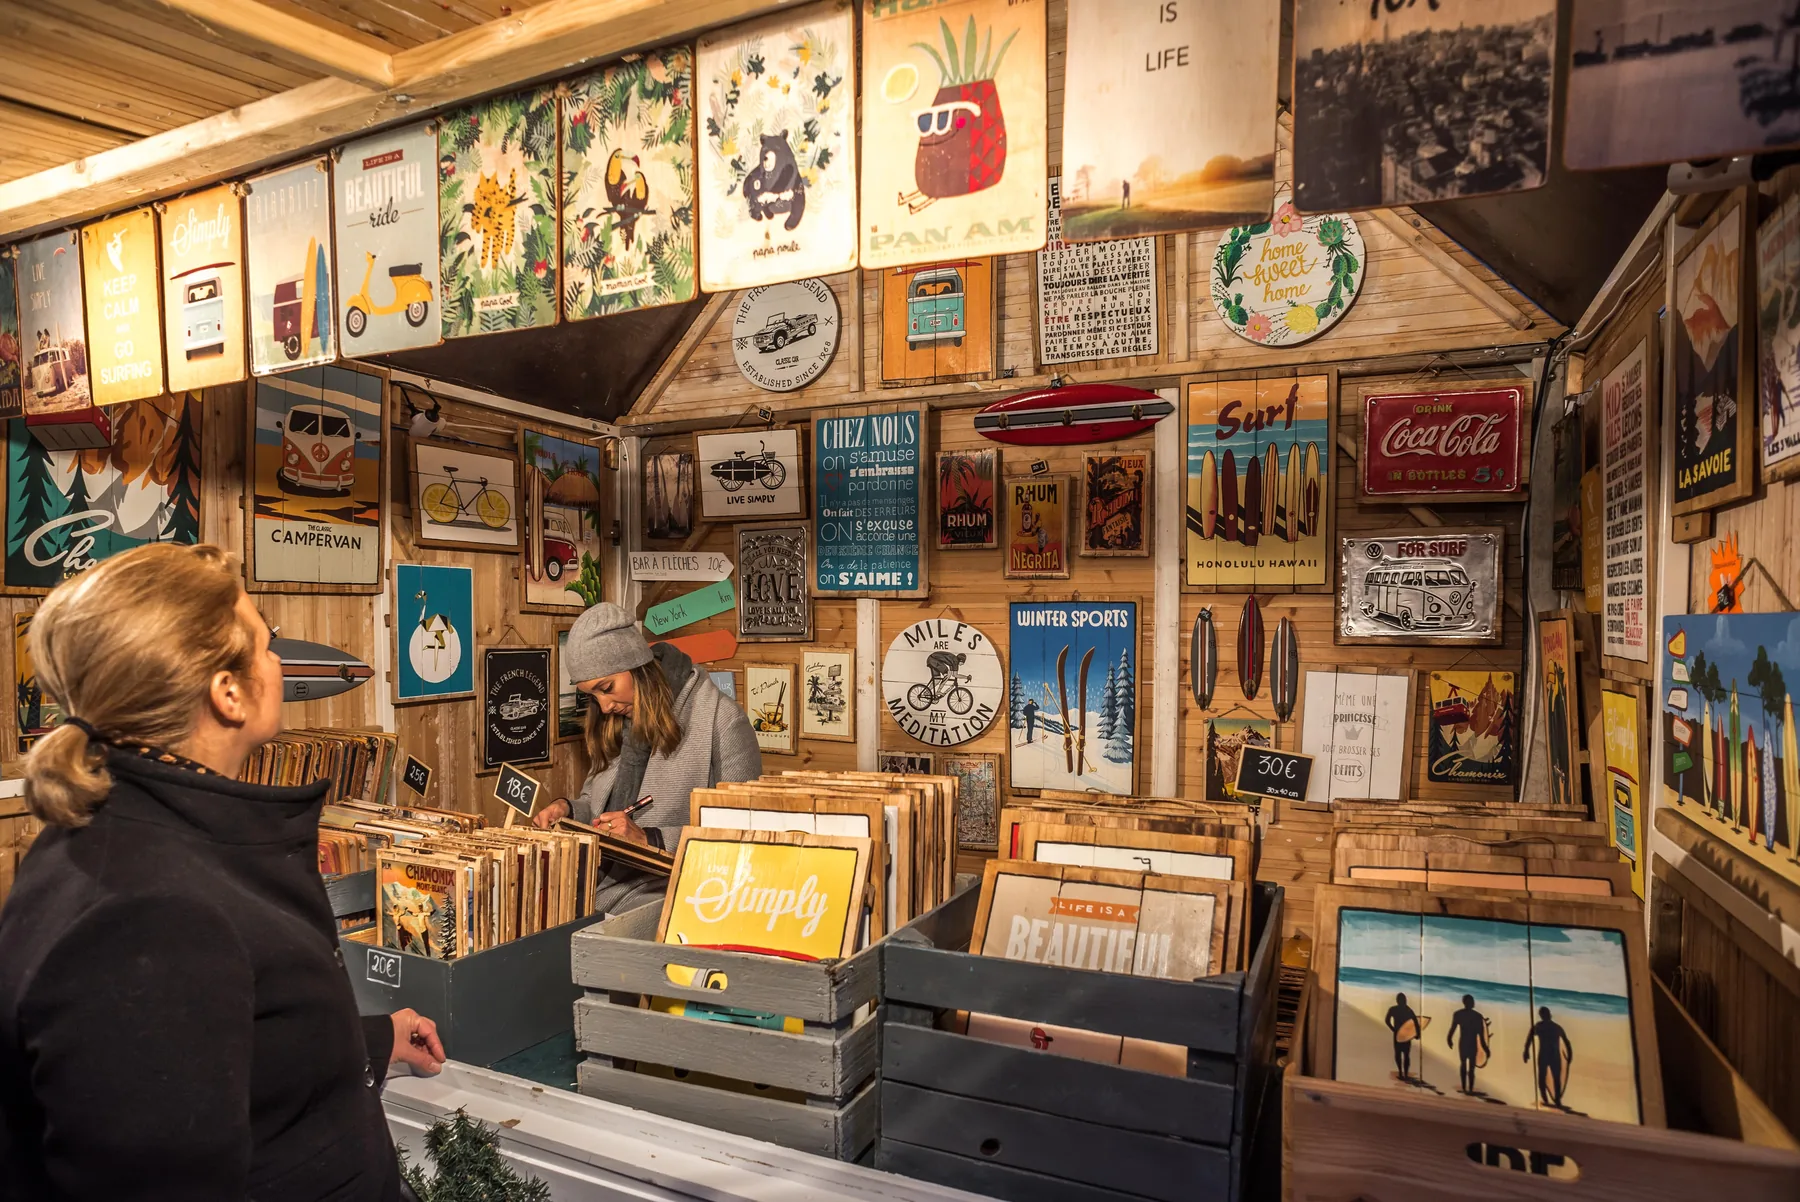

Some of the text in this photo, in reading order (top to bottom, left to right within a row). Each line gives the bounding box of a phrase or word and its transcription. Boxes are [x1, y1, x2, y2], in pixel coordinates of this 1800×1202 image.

[1160, 2, 1178, 24] IS
[1145, 46, 1190, 72] LIFE
[364, 158, 384, 167] LIFE
[345, 161, 425, 215] BEAUTIFUL
[368, 196, 400, 229] ride
[170, 202, 232, 257] Simply
[869, 226, 953, 251] PAN
[963, 215, 1036, 240] AM
[752, 243, 802, 260] papa poule
[1043, 248, 1090, 261] RESTER
[1099, 237, 1150, 252] MOTIVÉ
[1043, 248, 1150, 268] TOUJOURS ESSAYER
[1260, 238, 1308, 262] home
[1126, 256, 1150, 264] MERCI
[1243, 254, 1318, 286] sweet
[32, 263, 46, 282] LIVE
[1044, 270, 1150, 290] TOUJOURS DIRE LA VÉRITÉ
[1060, 270, 1090, 280] JAMAIS
[104, 274, 137, 297] KEEP
[1066, 286, 1126, 300] PARLER BOUCHE
[1262, 283, 1312, 303] home
[104, 296, 140, 320] CALM
[736, 302, 751, 325] THE
[1044, 298, 1092, 309] CROIRE
[1044, 298, 1151, 316] NE PAS HURLER
[1044, 306, 1151, 325] ÊTRE RESPECTUEUX
[1045, 314, 1152, 332] TENIR SES PROMESSES
[1045, 330, 1086, 338] PARDONNER
[1086, 325, 1107, 334] MÊME
[1046, 338, 1068, 346] FAIRE
[1086, 333, 1103, 341] QUE
[114, 340, 134, 358] GO
[1046, 344, 1152, 360] TRANSGRESSER LES RÈGLES
[1064, 342, 1096, 351] TEMPS
[100, 360, 152, 385] SURFING
[742, 340, 832, 388] ESTABLISHED SINCE 1968
[1216, 383, 1300, 440] Surf
[1415, 404, 1453, 414] DRINK
[1606, 382, 1621, 422] KID
[823, 414, 915, 450] CHEZ NOUS
[1380, 413, 1508, 458] Coca-Cola
[1606, 417, 1621, 450] RULES
[822, 448, 915, 471] on s'amuse
[1119, 459, 1144, 469] VIEUX
[1679, 448, 1732, 488] LA SAVOIE
[850, 464, 914, 478] s'embrasse
[1388, 470, 1466, 481] IN BOTTLES
[848, 476, 914, 496] pardonne
[1015, 484, 1058, 506] RHUM
[726, 494, 776, 504] LIVE SIMPLY
[822, 506, 916, 517] On fait DES ERREURS
[948, 514, 987, 528] RHUM
[820, 518, 914, 542] ON s'excuse
[856, 530, 916, 541] accorde une
[1102, 516, 1130, 536] FANTAISIE
[271, 529, 362, 550] CAMPERVAN
[818, 542, 918, 556] DEUXIÈME CHANCE
[1398, 540, 1468, 558] FOR SURF
[776, 546, 792, 557] NEED
[1012, 548, 1060, 570] NEGRITA
[633, 556, 650, 570] BAR
[662, 554, 700, 570] FLÈCHES
[708, 556, 726, 574] 10€
[820, 558, 912, 573] On patience
[1196, 558, 1318, 570] HONOLULU HAWAII
[746, 574, 802, 603] LOVE
[820, 572, 913, 586] on S'AIME !
[718, 590, 732, 604] km
[652, 604, 688, 628] New York
[748, 606, 764, 614] LOVE
[1017, 610, 1128, 628] WINTER SPORTS
[904, 620, 982, 650] MILES
[934, 641, 949, 650] ARE
[490, 668, 546, 696] THE FRENCH LEGEND
[1335, 692, 1376, 706] MÊME UNE
[888, 698, 994, 745] MEDITATION
[930, 712, 946, 723] MY
[1334, 713, 1376, 724] PRINCESSE
[490, 724, 538, 744] ESTABLISHED SINCE
[1322, 744, 1380, 757] DOIT BROSSER SES
[1258, 755, 1298, 778] 30€
[1334, 764, 1363, 777] DENTS
[1432, 750, 1506, 779] Chamonix
[410, 765, 426, 786] 25€
[506, 777, 532, 804] 18€
[406, 864, 456, 886] CHAMONIX
[708, 864, 729, 875] LIVE
[416, 882, 447, 894] MONT-BLANC
[685, 857, 829, 938] Simply
[1056, 901, 1126, 917] LIFE IS A
[1006, 914, 1172, 980] BEAUTIFUL
[372, 954, 396, 978] 20€
